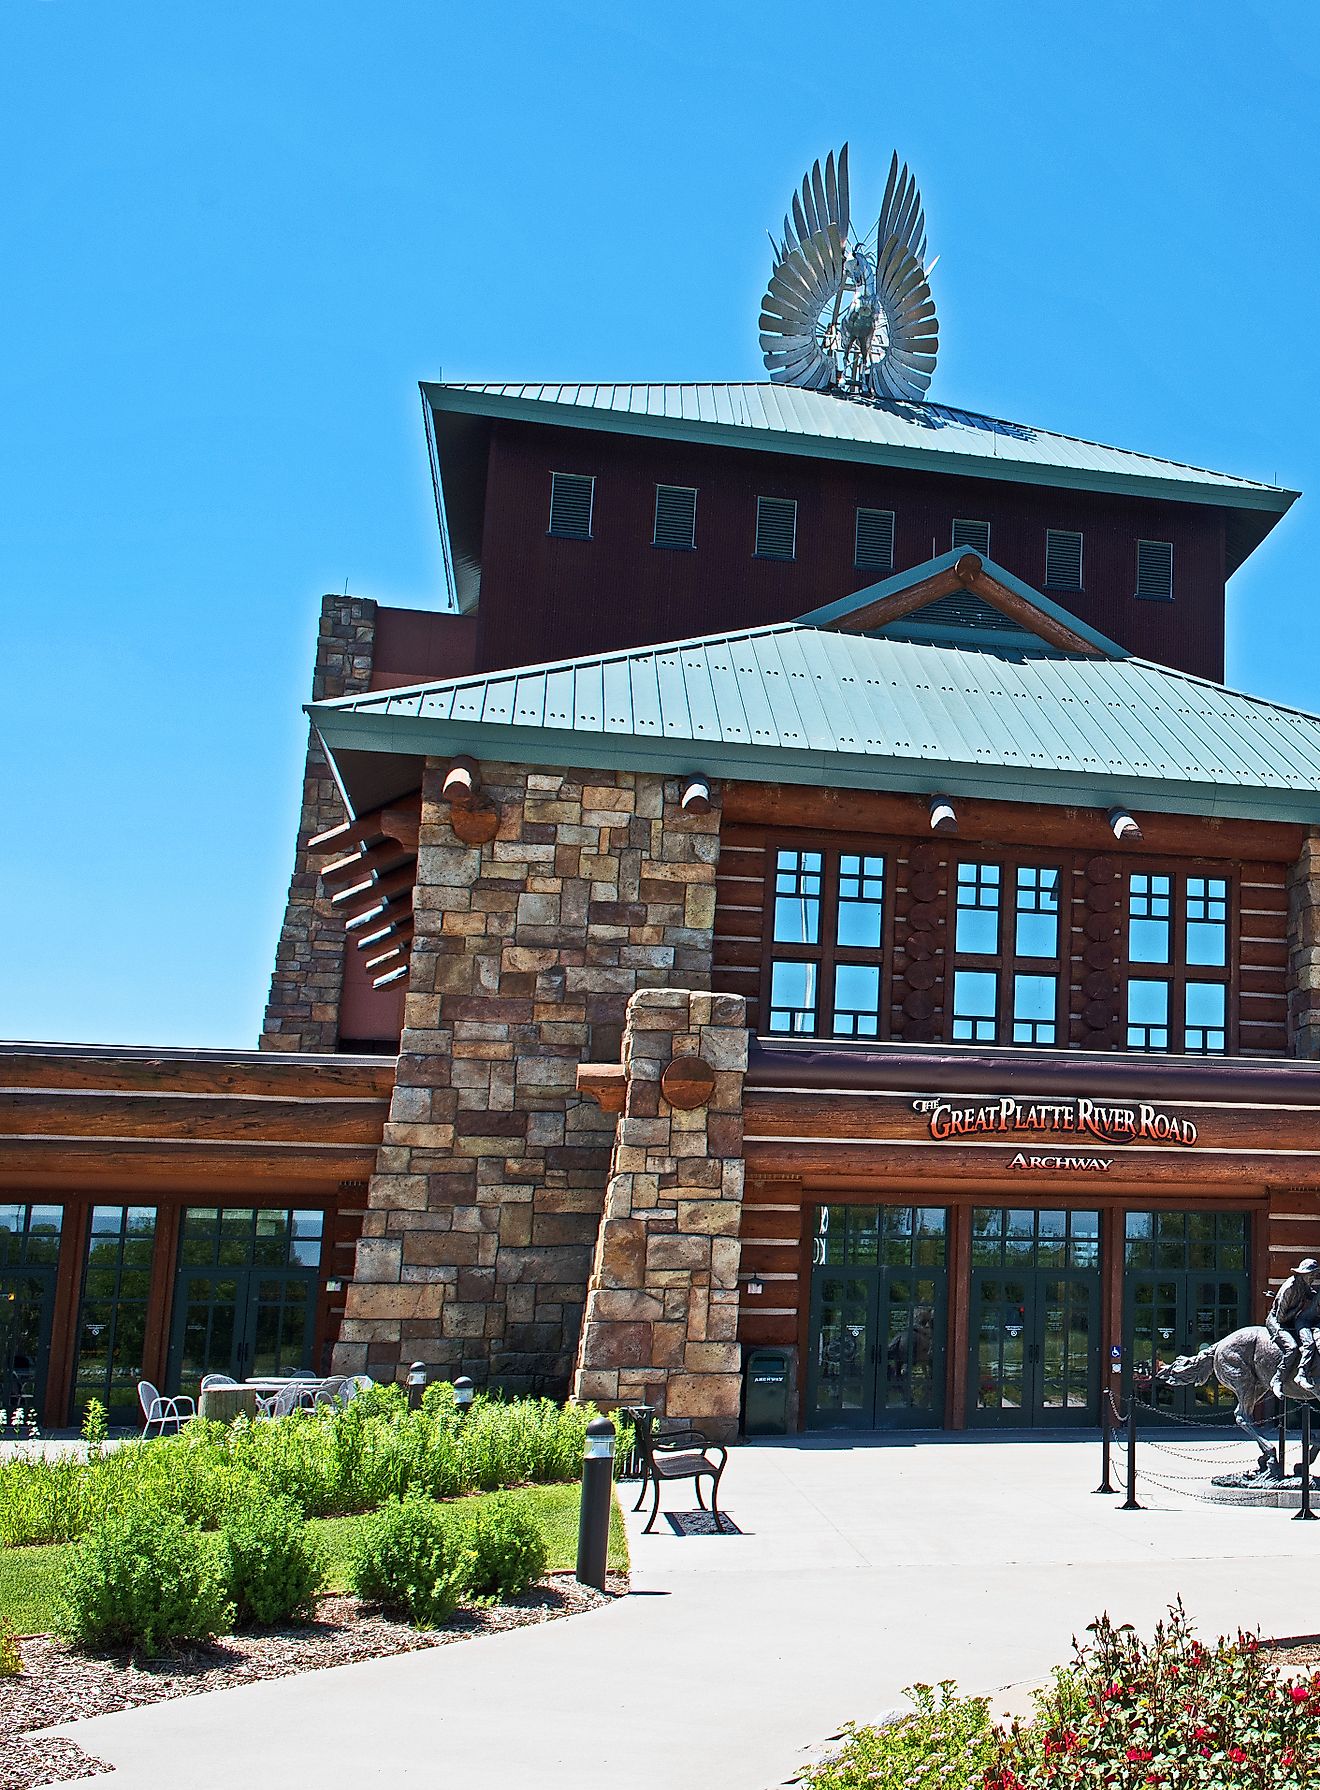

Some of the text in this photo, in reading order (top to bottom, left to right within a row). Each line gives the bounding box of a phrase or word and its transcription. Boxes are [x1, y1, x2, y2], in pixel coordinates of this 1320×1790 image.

[930, 1104, 1000, 1140] GREAT
[1000, 1098, 1074, 1131] PLATTE
[1077, 1098, 1136, 1143] RIVER
[1138, 1104, 1198, 1145] ROAD
[1008, 1153, 1114, 1172] ARCHWAY
